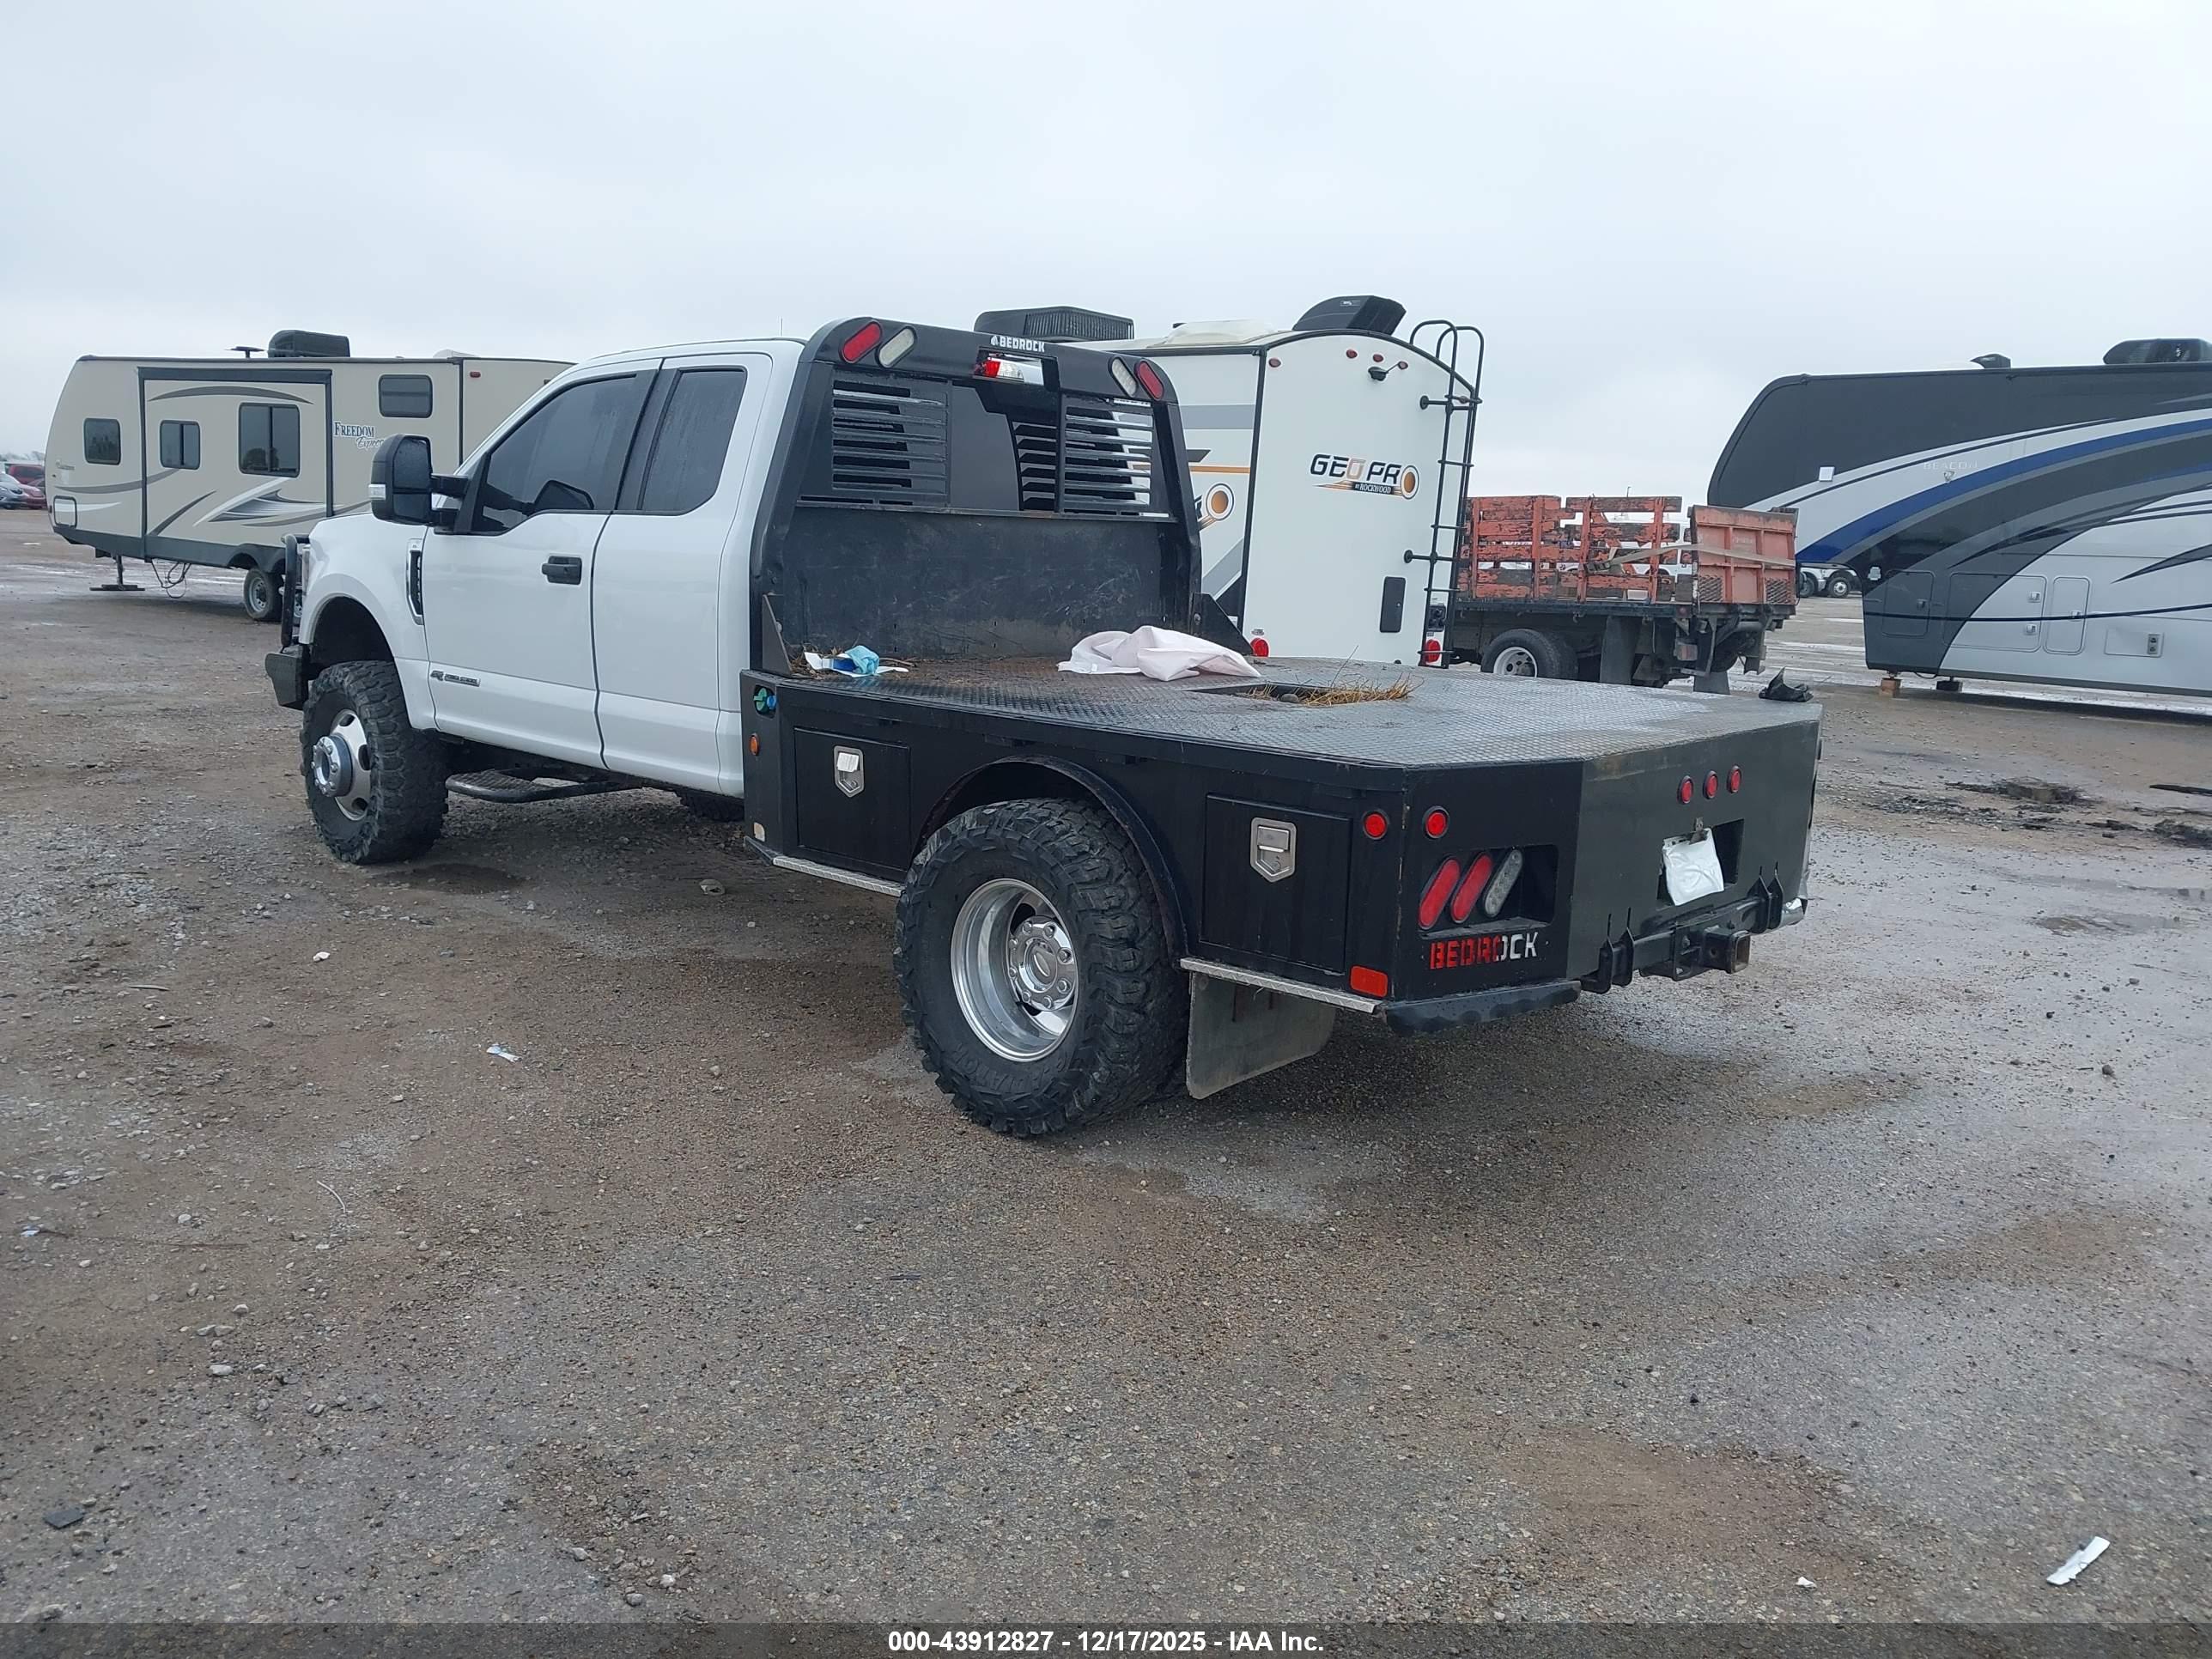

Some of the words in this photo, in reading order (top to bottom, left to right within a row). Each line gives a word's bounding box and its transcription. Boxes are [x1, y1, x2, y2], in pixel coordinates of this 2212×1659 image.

[1000, 336, 1045, 353] BEDROCK
[335, 422, 374, 438] FREEDOM
[1310, 453, 1366, 480] GEO
[1923, 460, 1978, 470] BEACON
[1359, 483, 1392, 494] ROCKWOOD
[1430, 932, 1539, 969] BEDROCK
